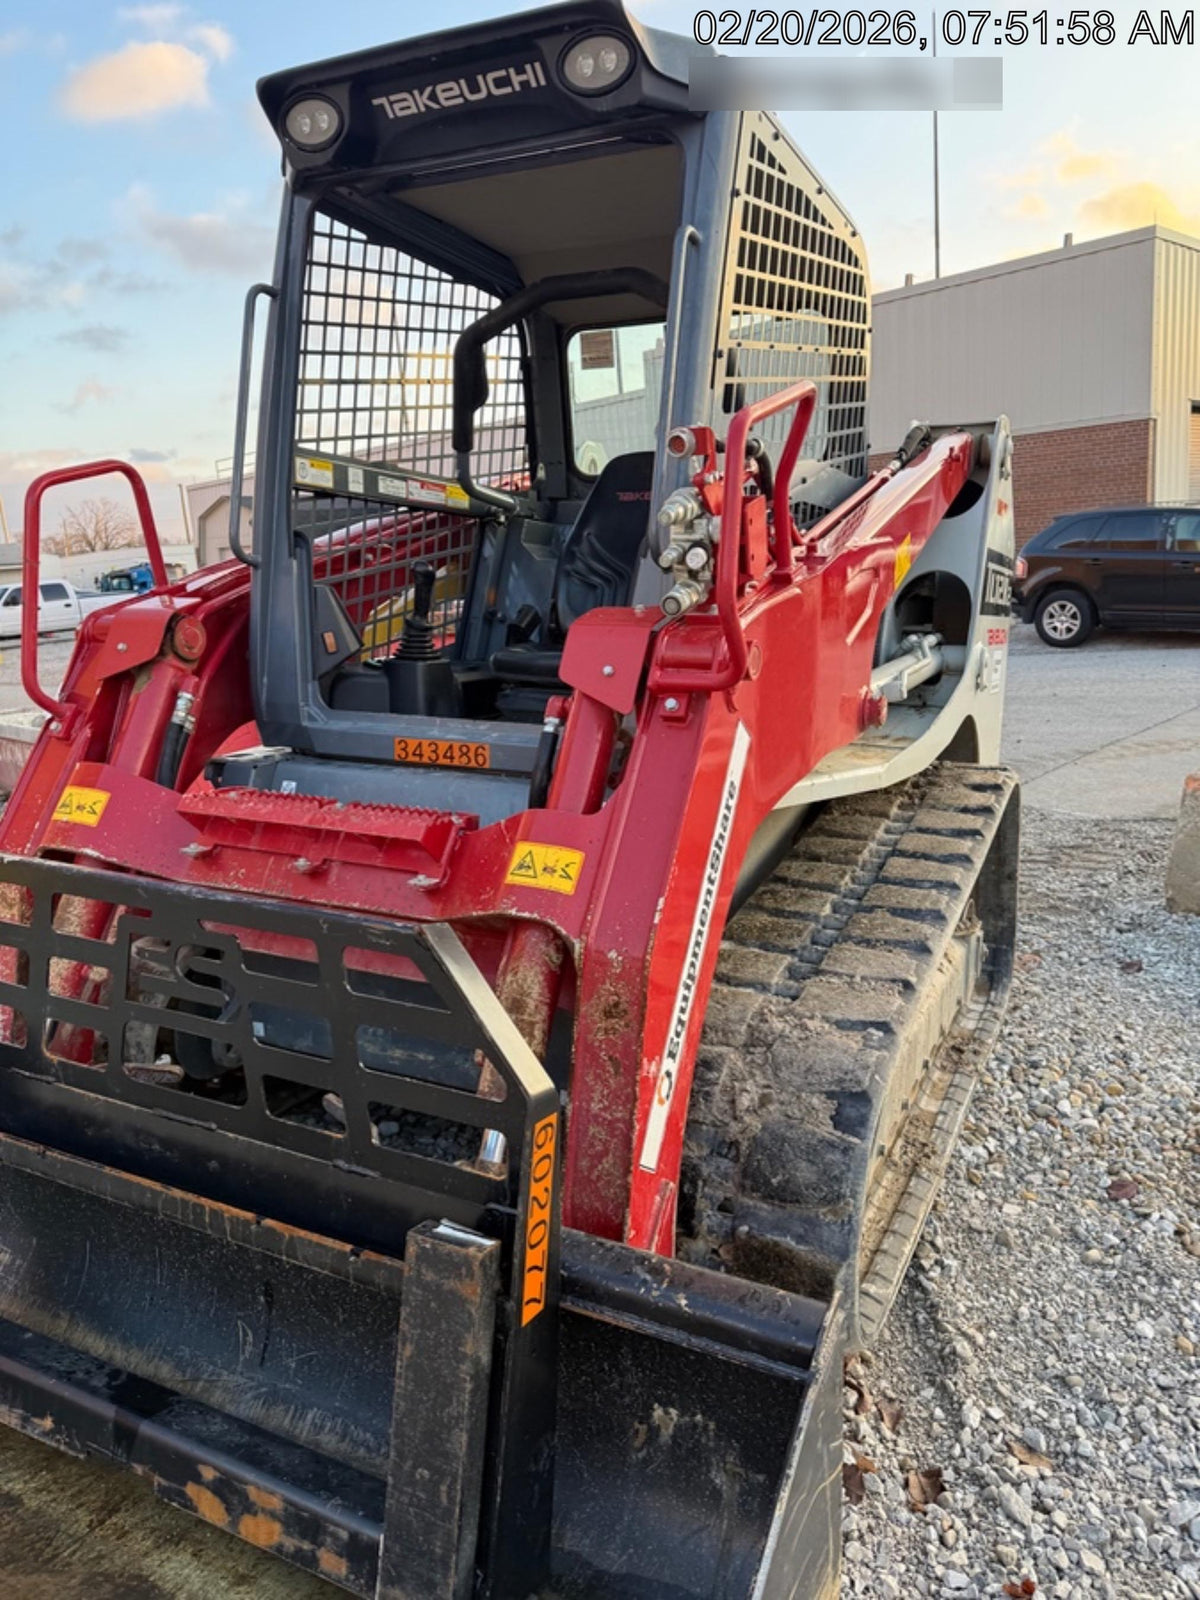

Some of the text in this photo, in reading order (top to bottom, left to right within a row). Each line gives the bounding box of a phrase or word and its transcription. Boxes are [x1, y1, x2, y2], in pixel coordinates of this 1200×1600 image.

[372, 61, 547, 120] TAKEUCHI
[397, 739, 487, 767] 343486
[667, 780, 737, 1063] EquipmentShare
[524, 1122, 554, 1307] 602077
